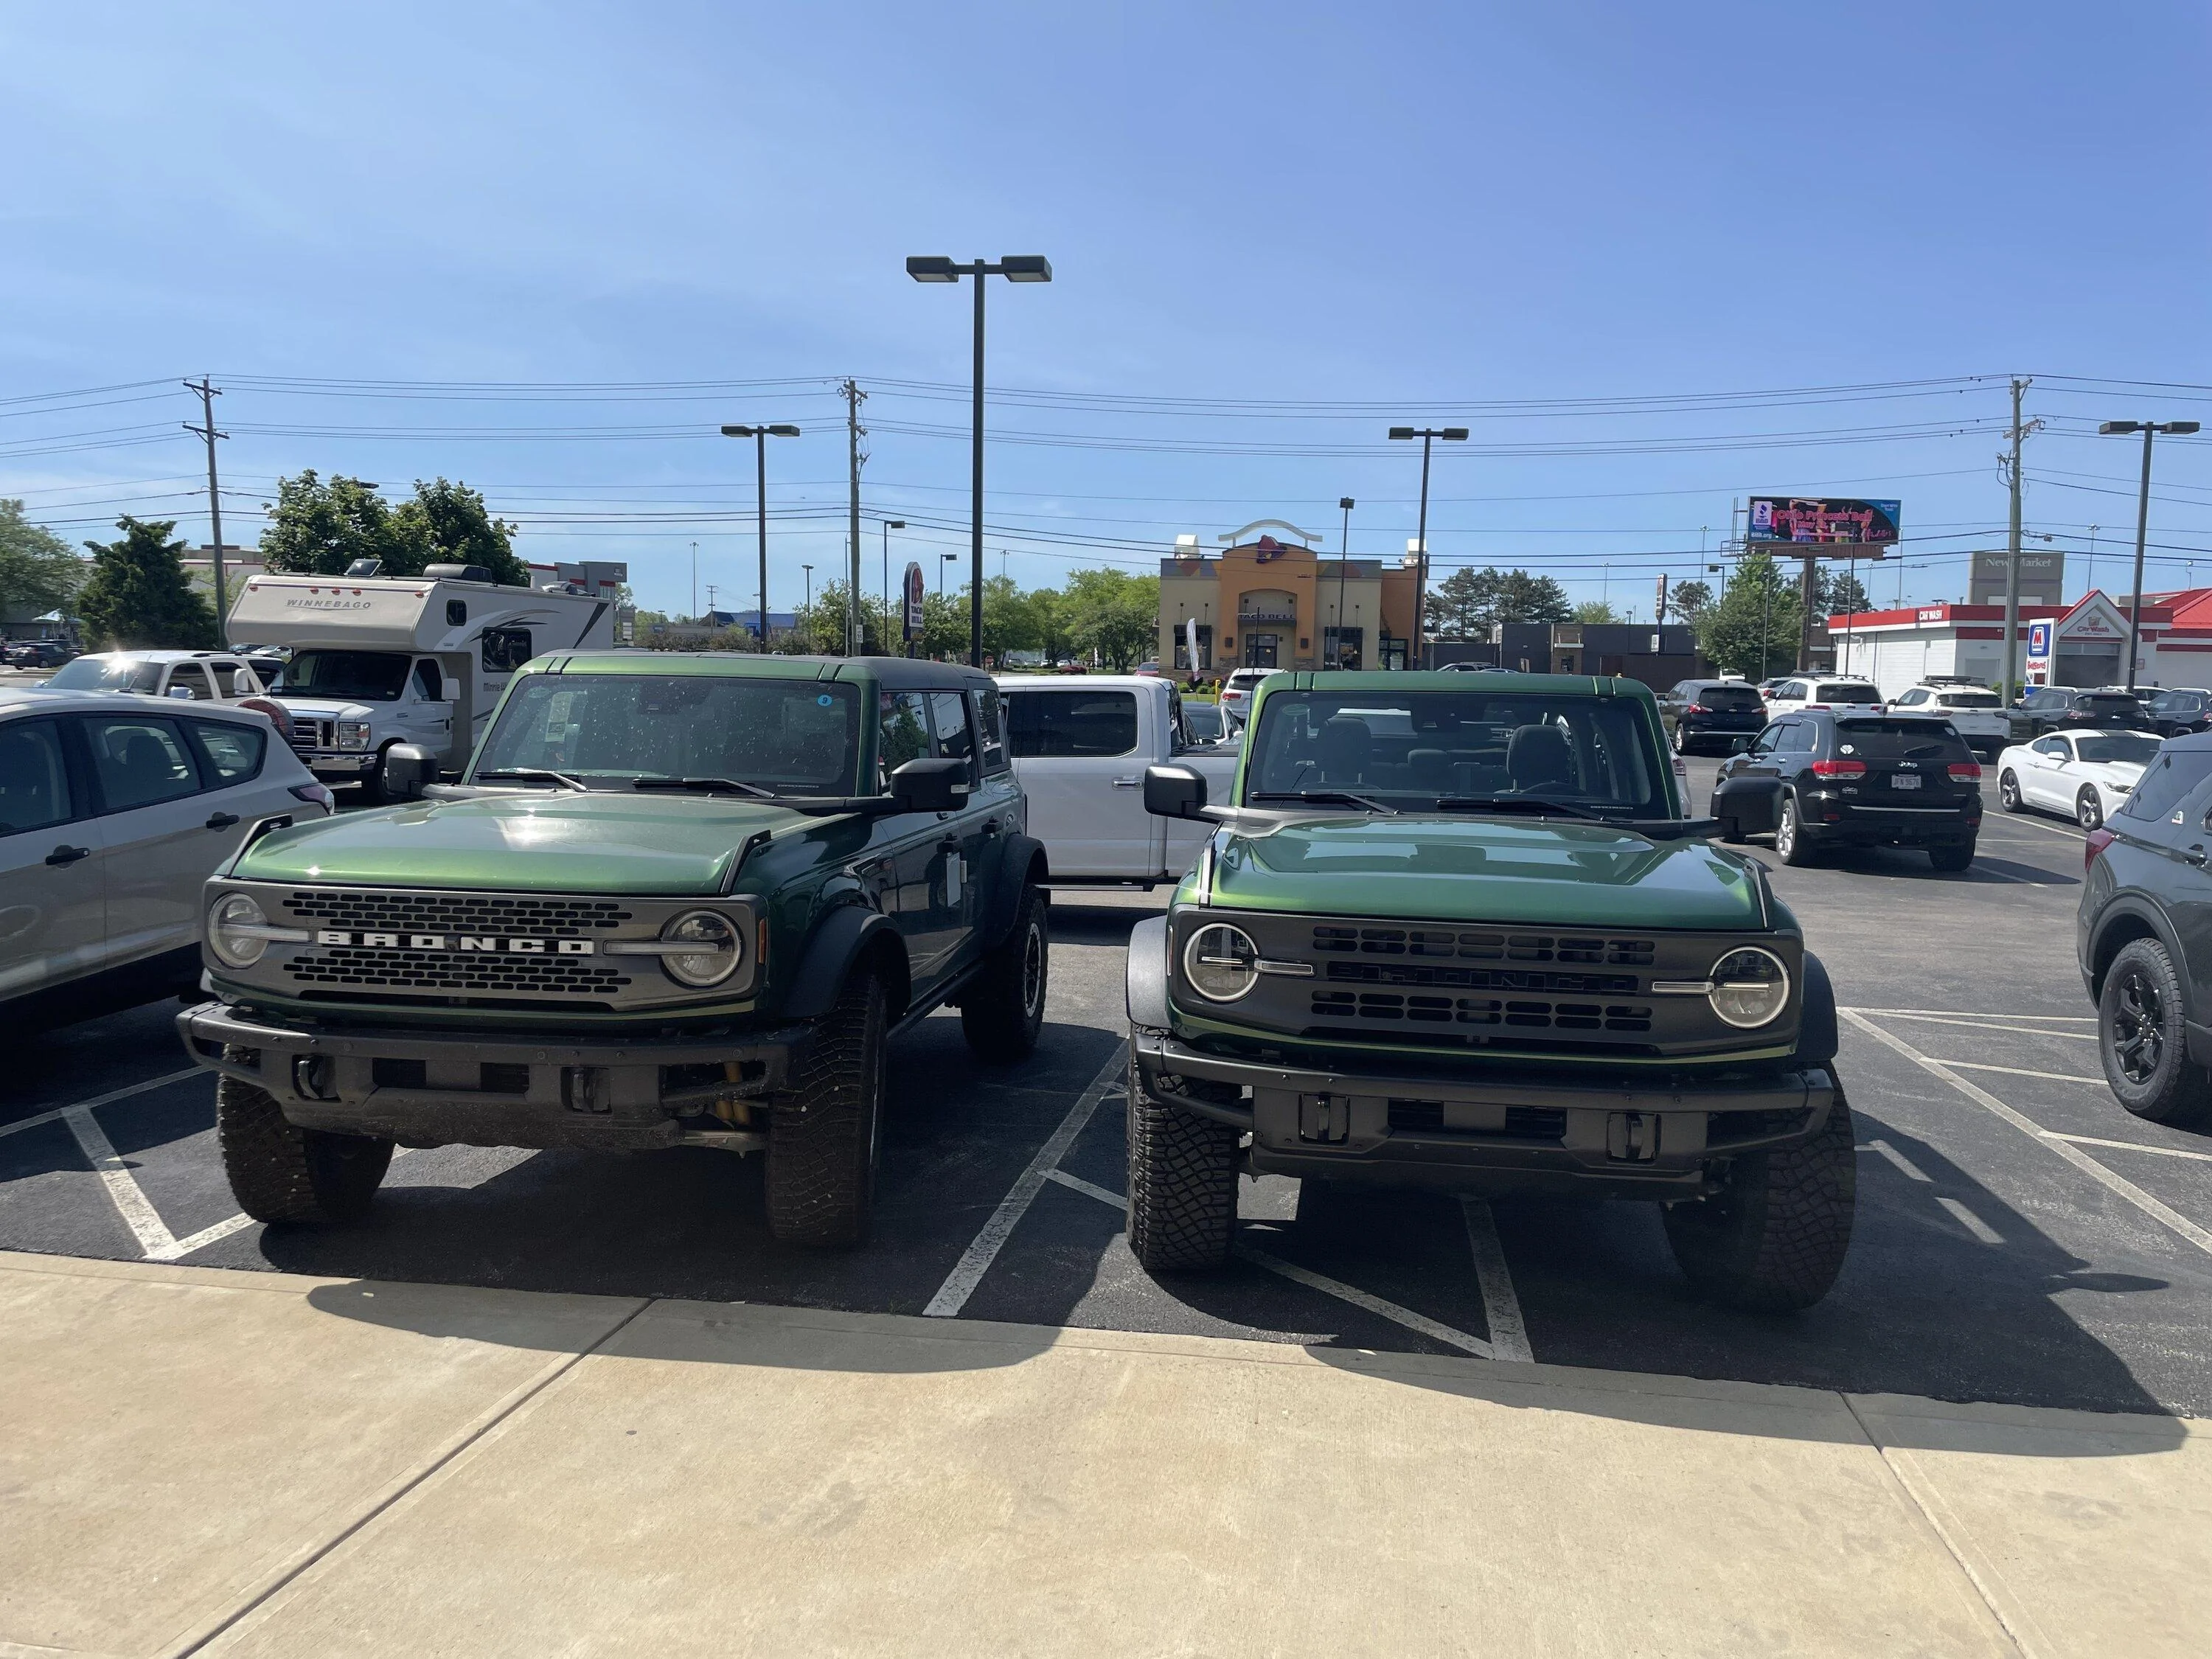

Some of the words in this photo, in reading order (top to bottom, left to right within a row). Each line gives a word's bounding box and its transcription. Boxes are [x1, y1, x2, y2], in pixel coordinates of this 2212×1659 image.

[1777, 509, 1804, 520] Ohio
[1806, 510, 1849, 521] Princess
[287, 599, 372, 608] WINNEBAGO
[911, 606, 922, 614] TACO
[1919, 611, 1928, 621] CAR
[1929, 610, 1942, 621] WASH
[2034, 631, 2042, 644] M
[318, 931, 595, 954] BRONCO
